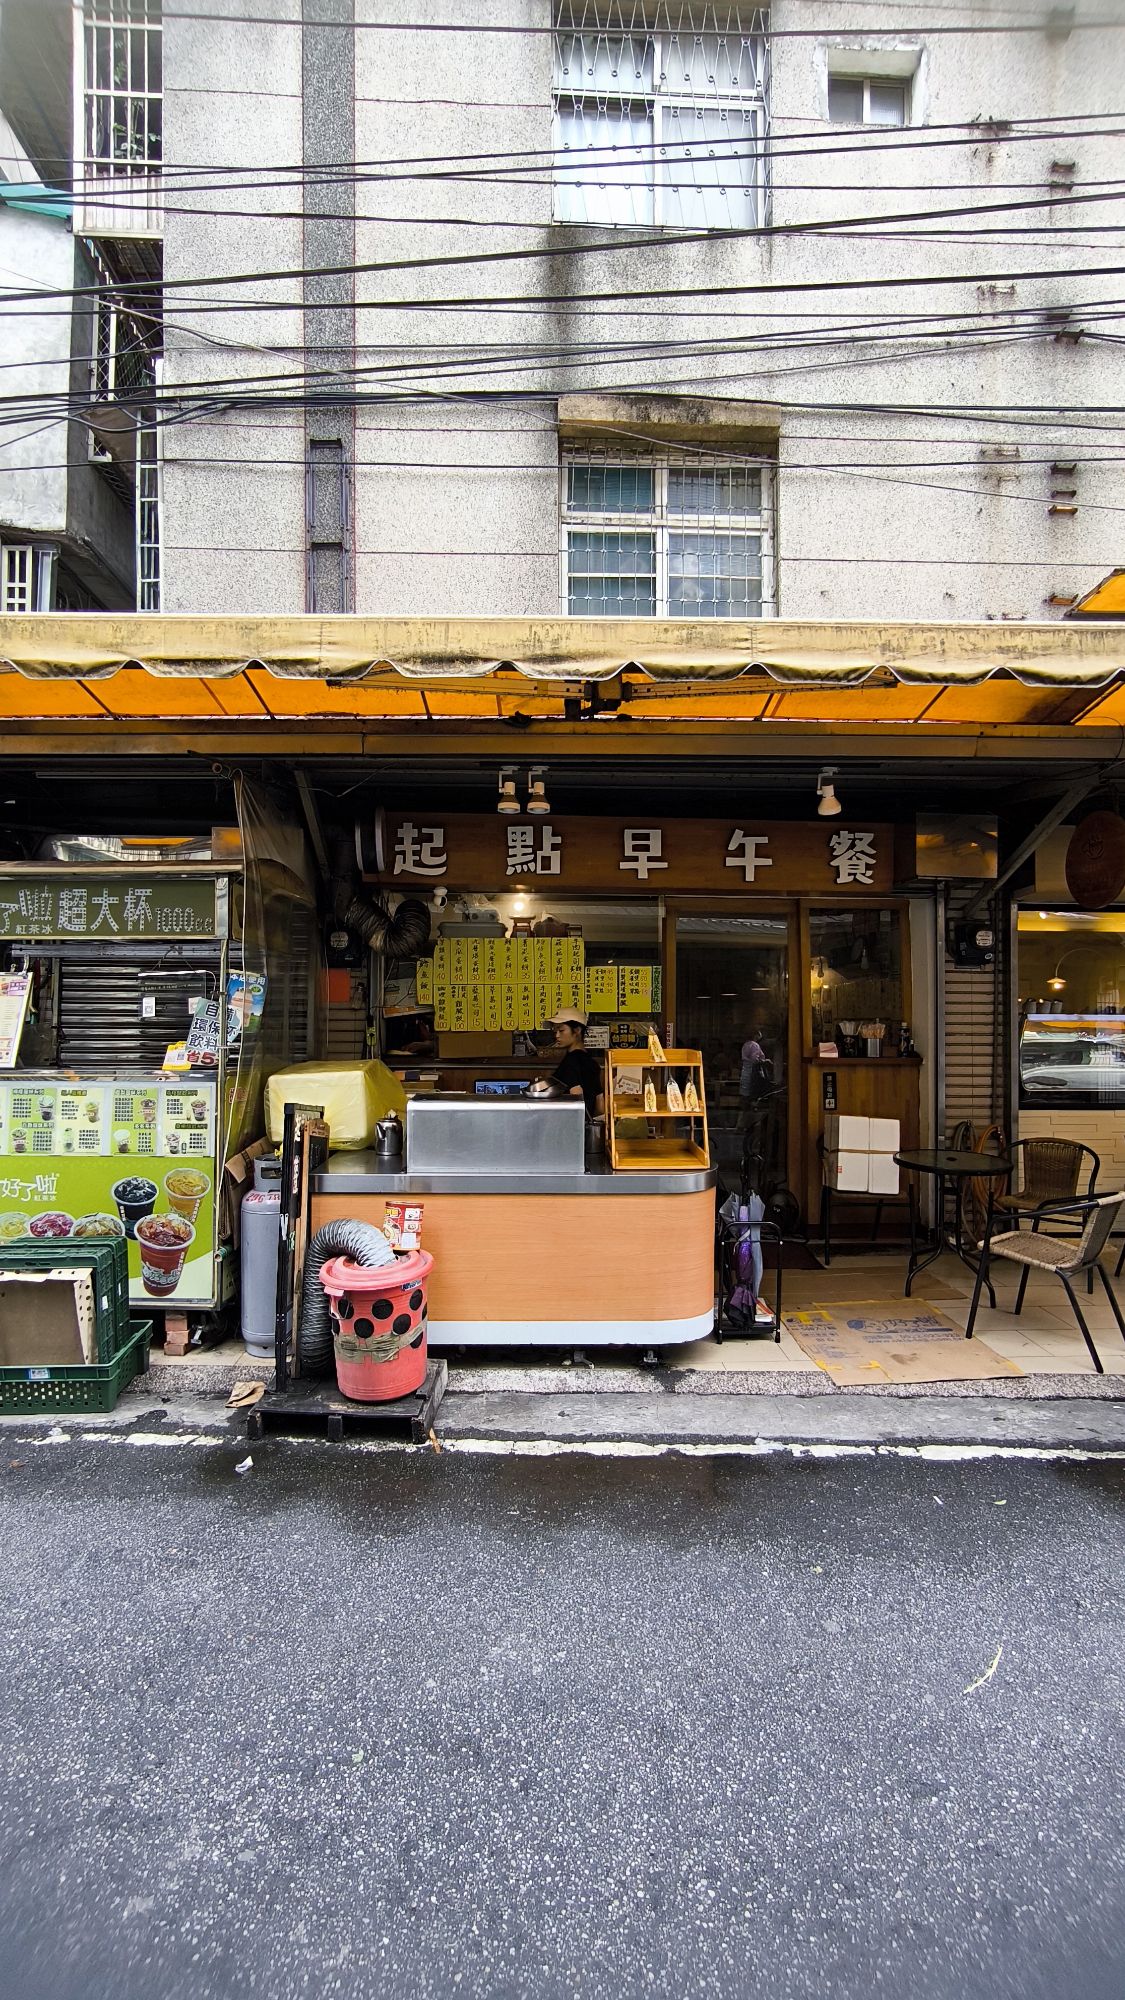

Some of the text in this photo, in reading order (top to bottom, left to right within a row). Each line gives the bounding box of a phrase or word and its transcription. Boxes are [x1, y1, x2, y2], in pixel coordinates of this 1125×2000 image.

[393, 822, 878, 885] 起點早午餐
[57, 887, 152, 932] 超大杯
[155, 907, 211, 932] 1000cc
[15, 924, 53, 934] 紅茶冰
[437, 972, 446, 980] 40
[570, 972, 582, 981] 60
[437, 1021, 447, 1029] 100
[472, 1018, 480, 1027] 15
[489, 1020, 497, 1028] 15
[189, 1033, 219, 1050] 飲料
[187, 1050, 219, 1065] 省5
